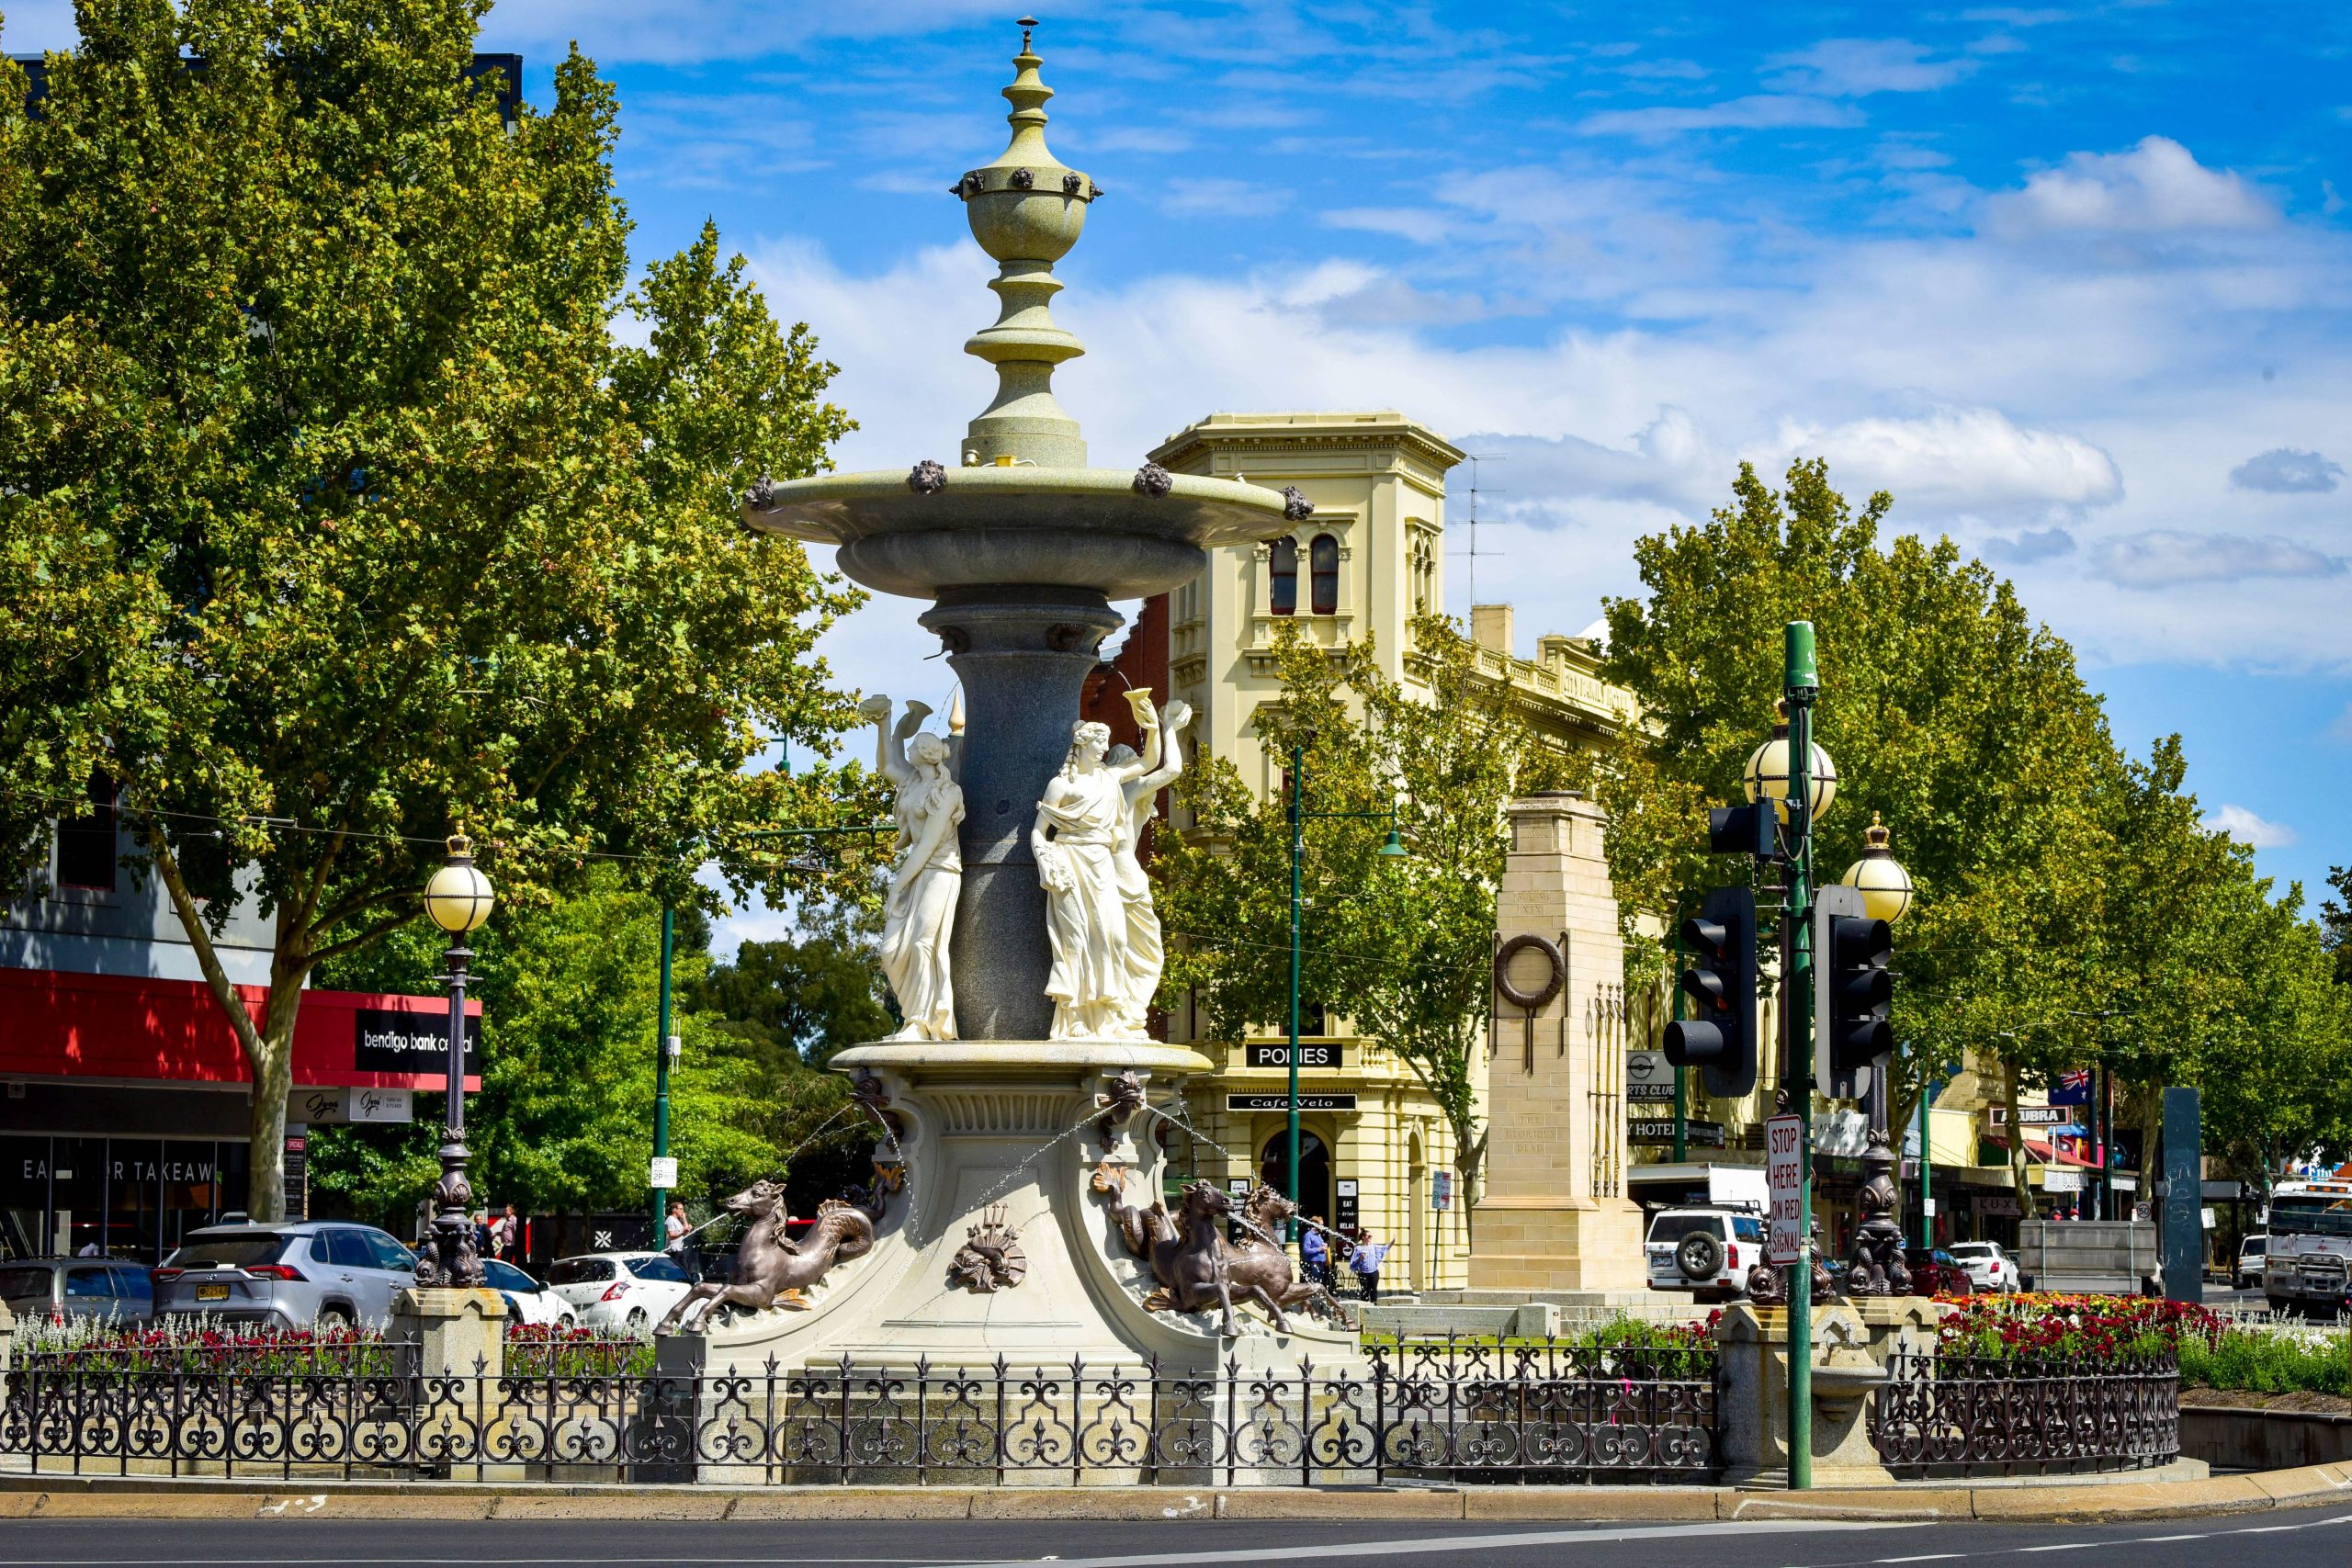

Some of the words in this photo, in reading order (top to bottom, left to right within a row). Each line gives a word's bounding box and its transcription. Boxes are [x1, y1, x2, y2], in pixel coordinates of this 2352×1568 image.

[365, 1030, 408, 1053] bendigo
[411, 1032, 436, 1051] bank
[438, 1035, 472, 1053] ceal
[1259, 1048, 1329, 1064] POIES
[1627, 1085, 1647, 1096] RTS
[1649, 1085, 1675, 1096] CLUB
[1250, 1099, 1288, 1109] Cafe
[1296, 1098, 1333, 1107] Velo
[1520, 1116, 1542, 1124] THE
[1819, 1123, 1832, 1133] ACE
[1849, 1123, 1869, 1133] CLU
[1772, 1128, 1797, 1154] STOP
[1516, 1144, 1544, 1153] DEAD
[24, 1160, 47, 1179] EA
[134, 1162, 213, 1181] TAKEAW
[1773, 1163, 1798, 1190] HERE
[1980, 1199, 2019, 1209] LUX
[2036, 1198, 2054, 1206] SHOP
[1771, 1200, 1782, 1222] ON
[1785, 1200, 1799, 1221] RED
[2139, 1207, 2149, 1215] 50
[1771, 1232, 1799, 1254] SIGNAL
